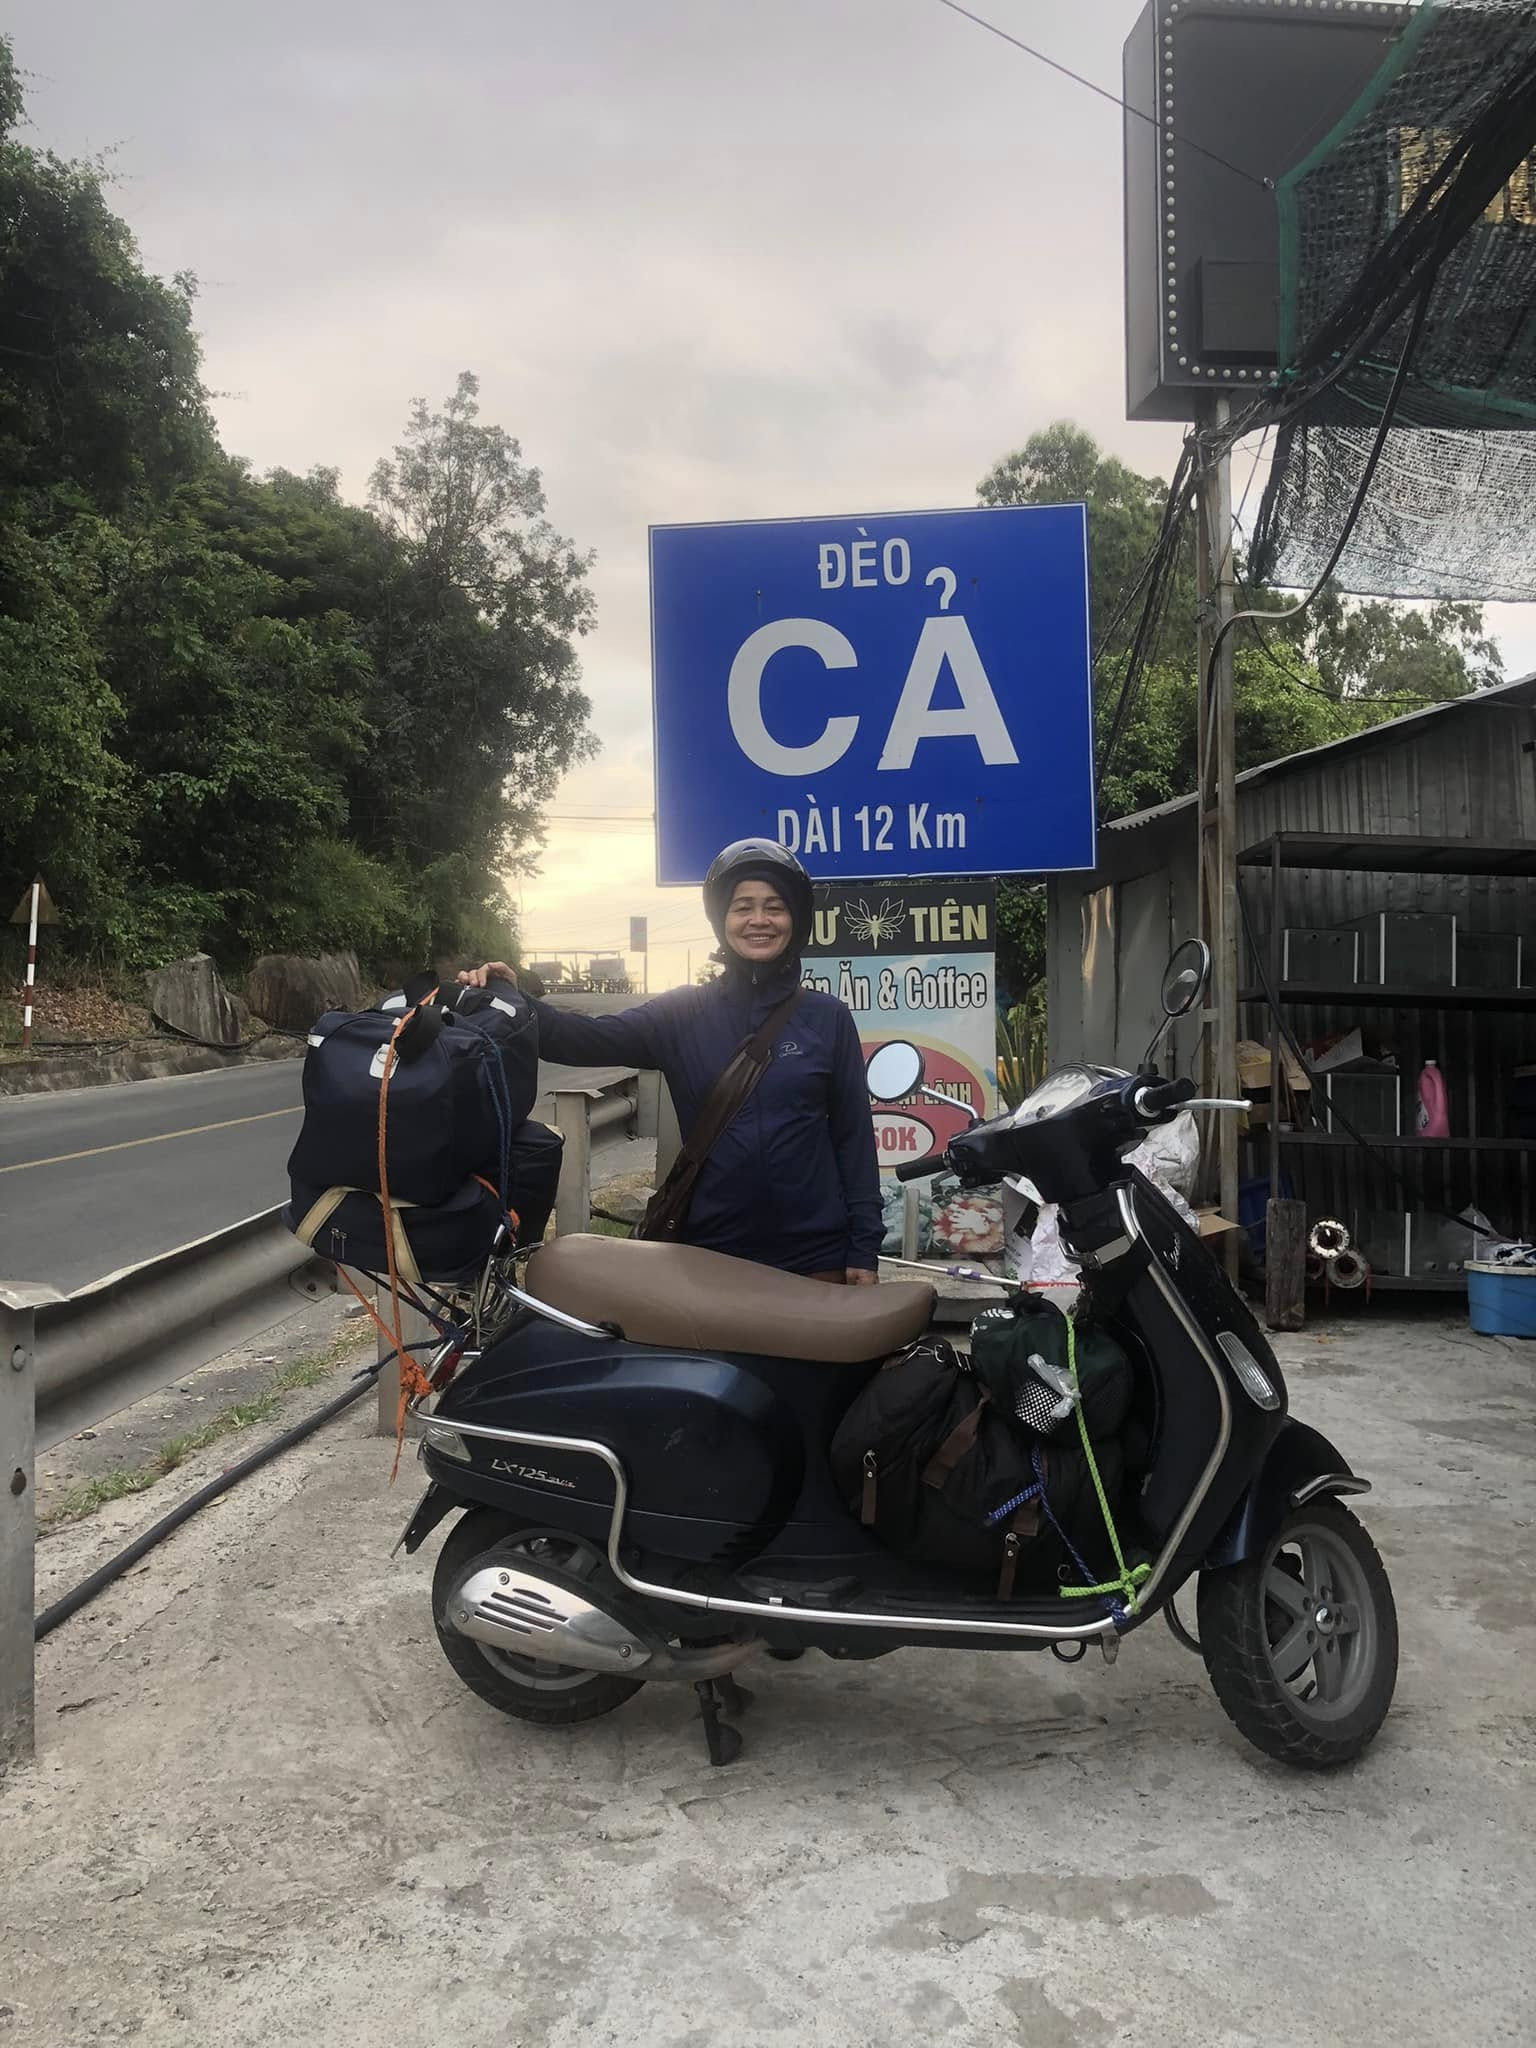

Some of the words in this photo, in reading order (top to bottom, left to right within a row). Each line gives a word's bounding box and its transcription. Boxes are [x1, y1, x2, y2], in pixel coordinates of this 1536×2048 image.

[818, 527, 911, 589] ĐÈO
[727, 566, 1020, 776] CẢ
[777, 794, 841, 854] DÀI
[855, 805, 894, 851] 12
[908, 803, 966, 849] Km
[909, 898, 988, 942] TIÊN
[838, 960, 871, 1011] Ăn
[877, 968, 898, 1011] &
[904, 966, 987, 1010] Coffee
